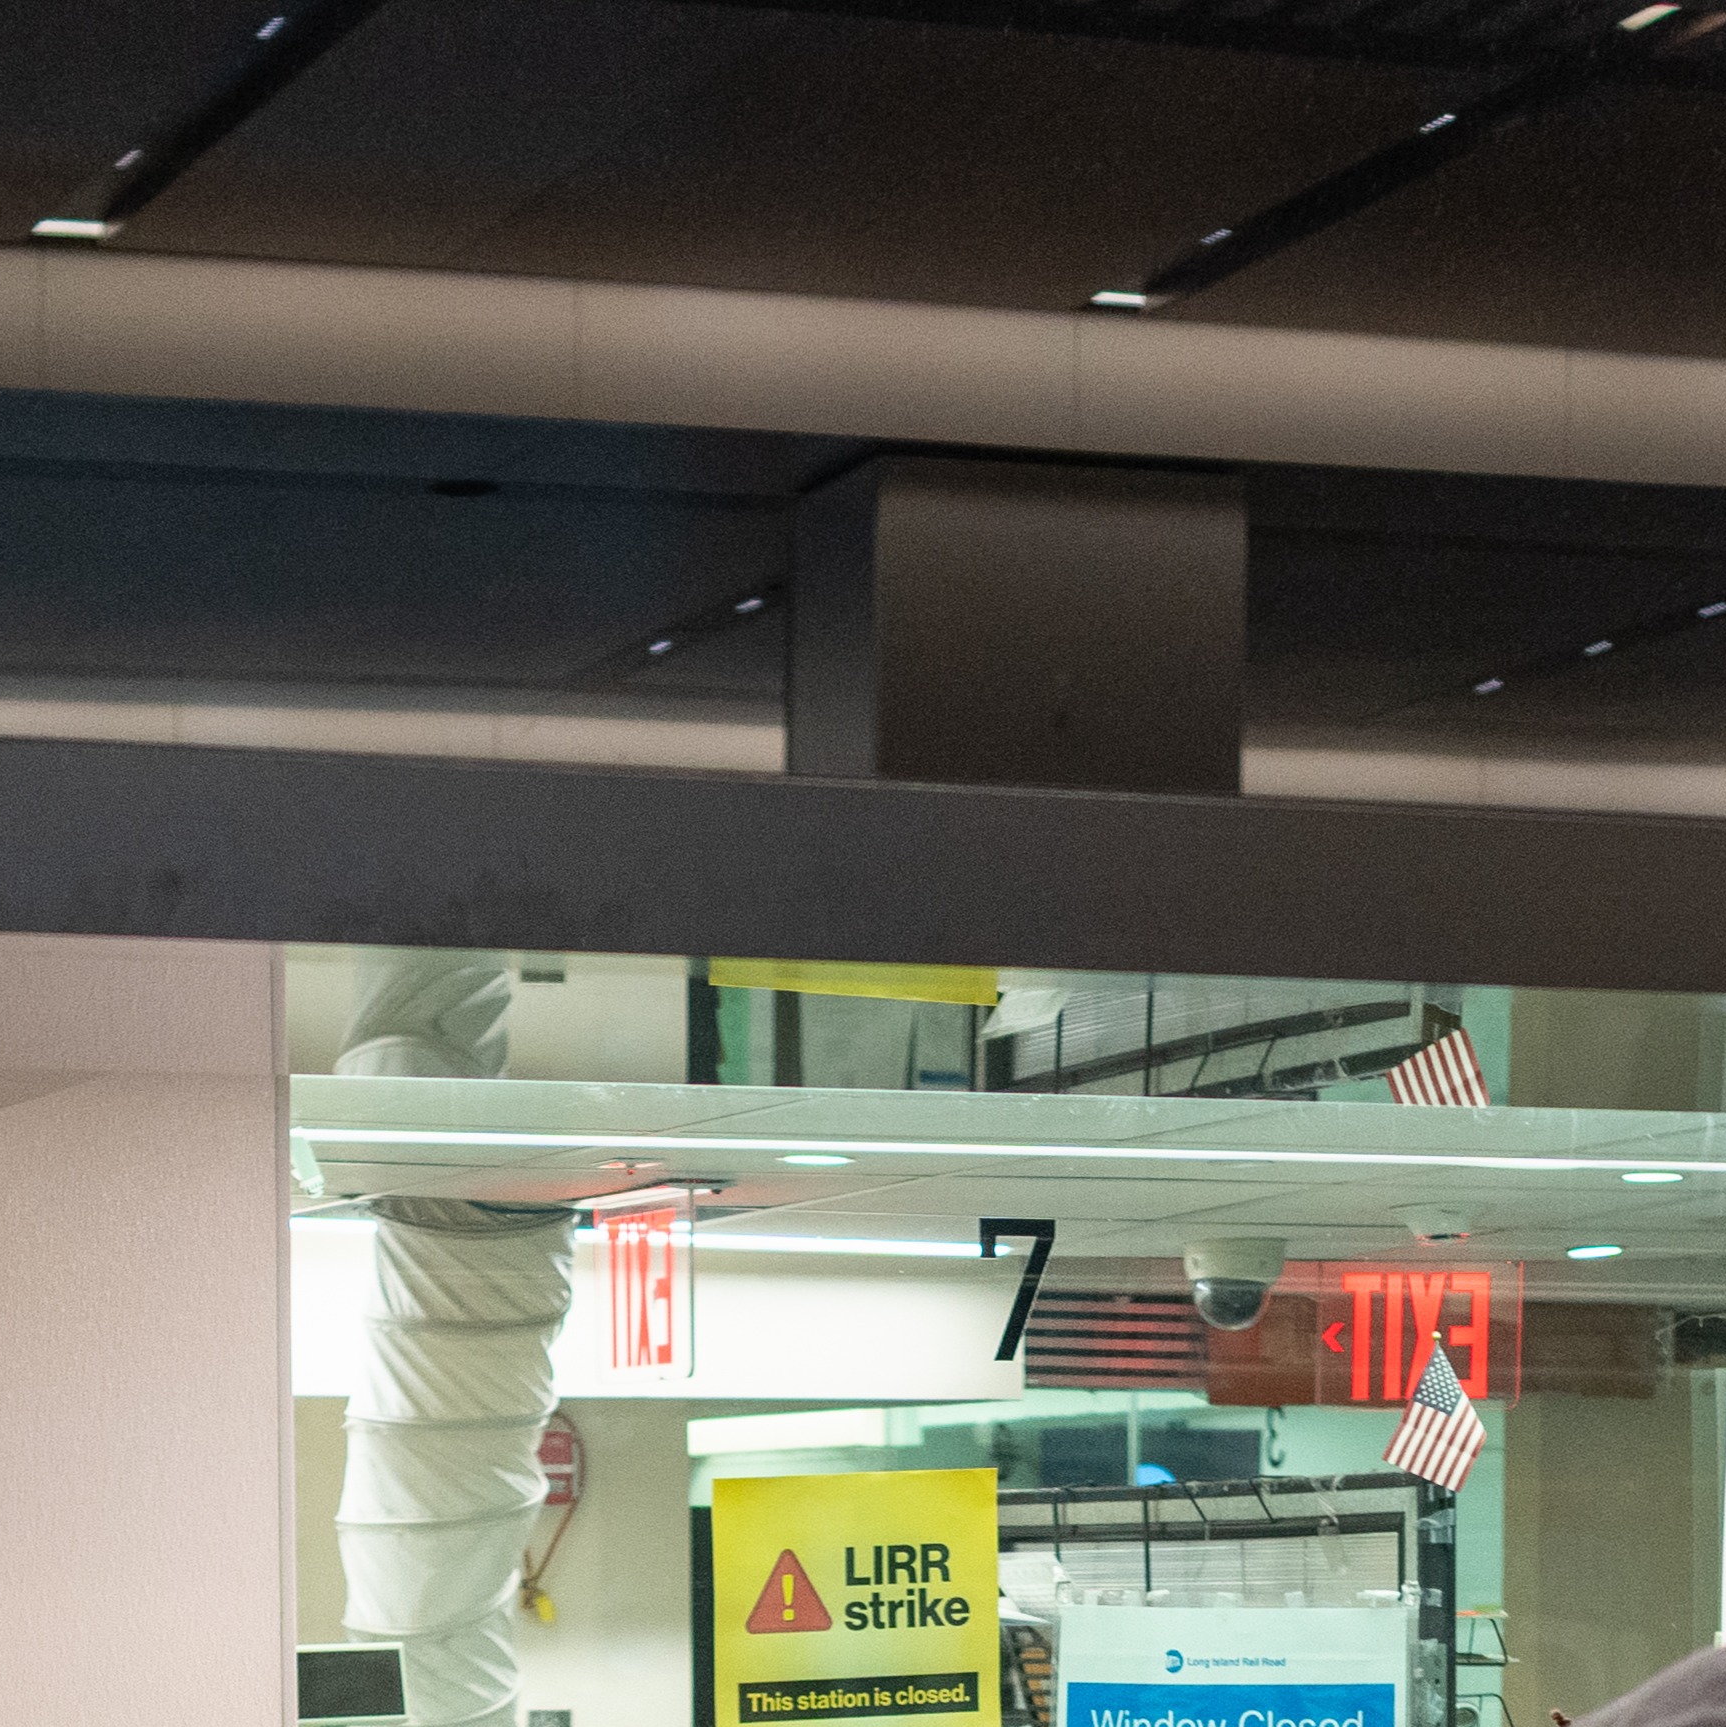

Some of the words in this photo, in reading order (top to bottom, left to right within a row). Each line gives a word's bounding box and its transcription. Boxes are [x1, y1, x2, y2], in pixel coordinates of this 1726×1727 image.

[979, 1217, 1056, 1362] 7
[845, 1543, 951, 1586] LIRR
[844, 1587, 970, 1631] strike
[746, 1691, 794, 1713] This
[796, 1688, 870, 1711] station
[873, 1687, 891, 1707] is
[895, 1683, 971, 1705] closed.
